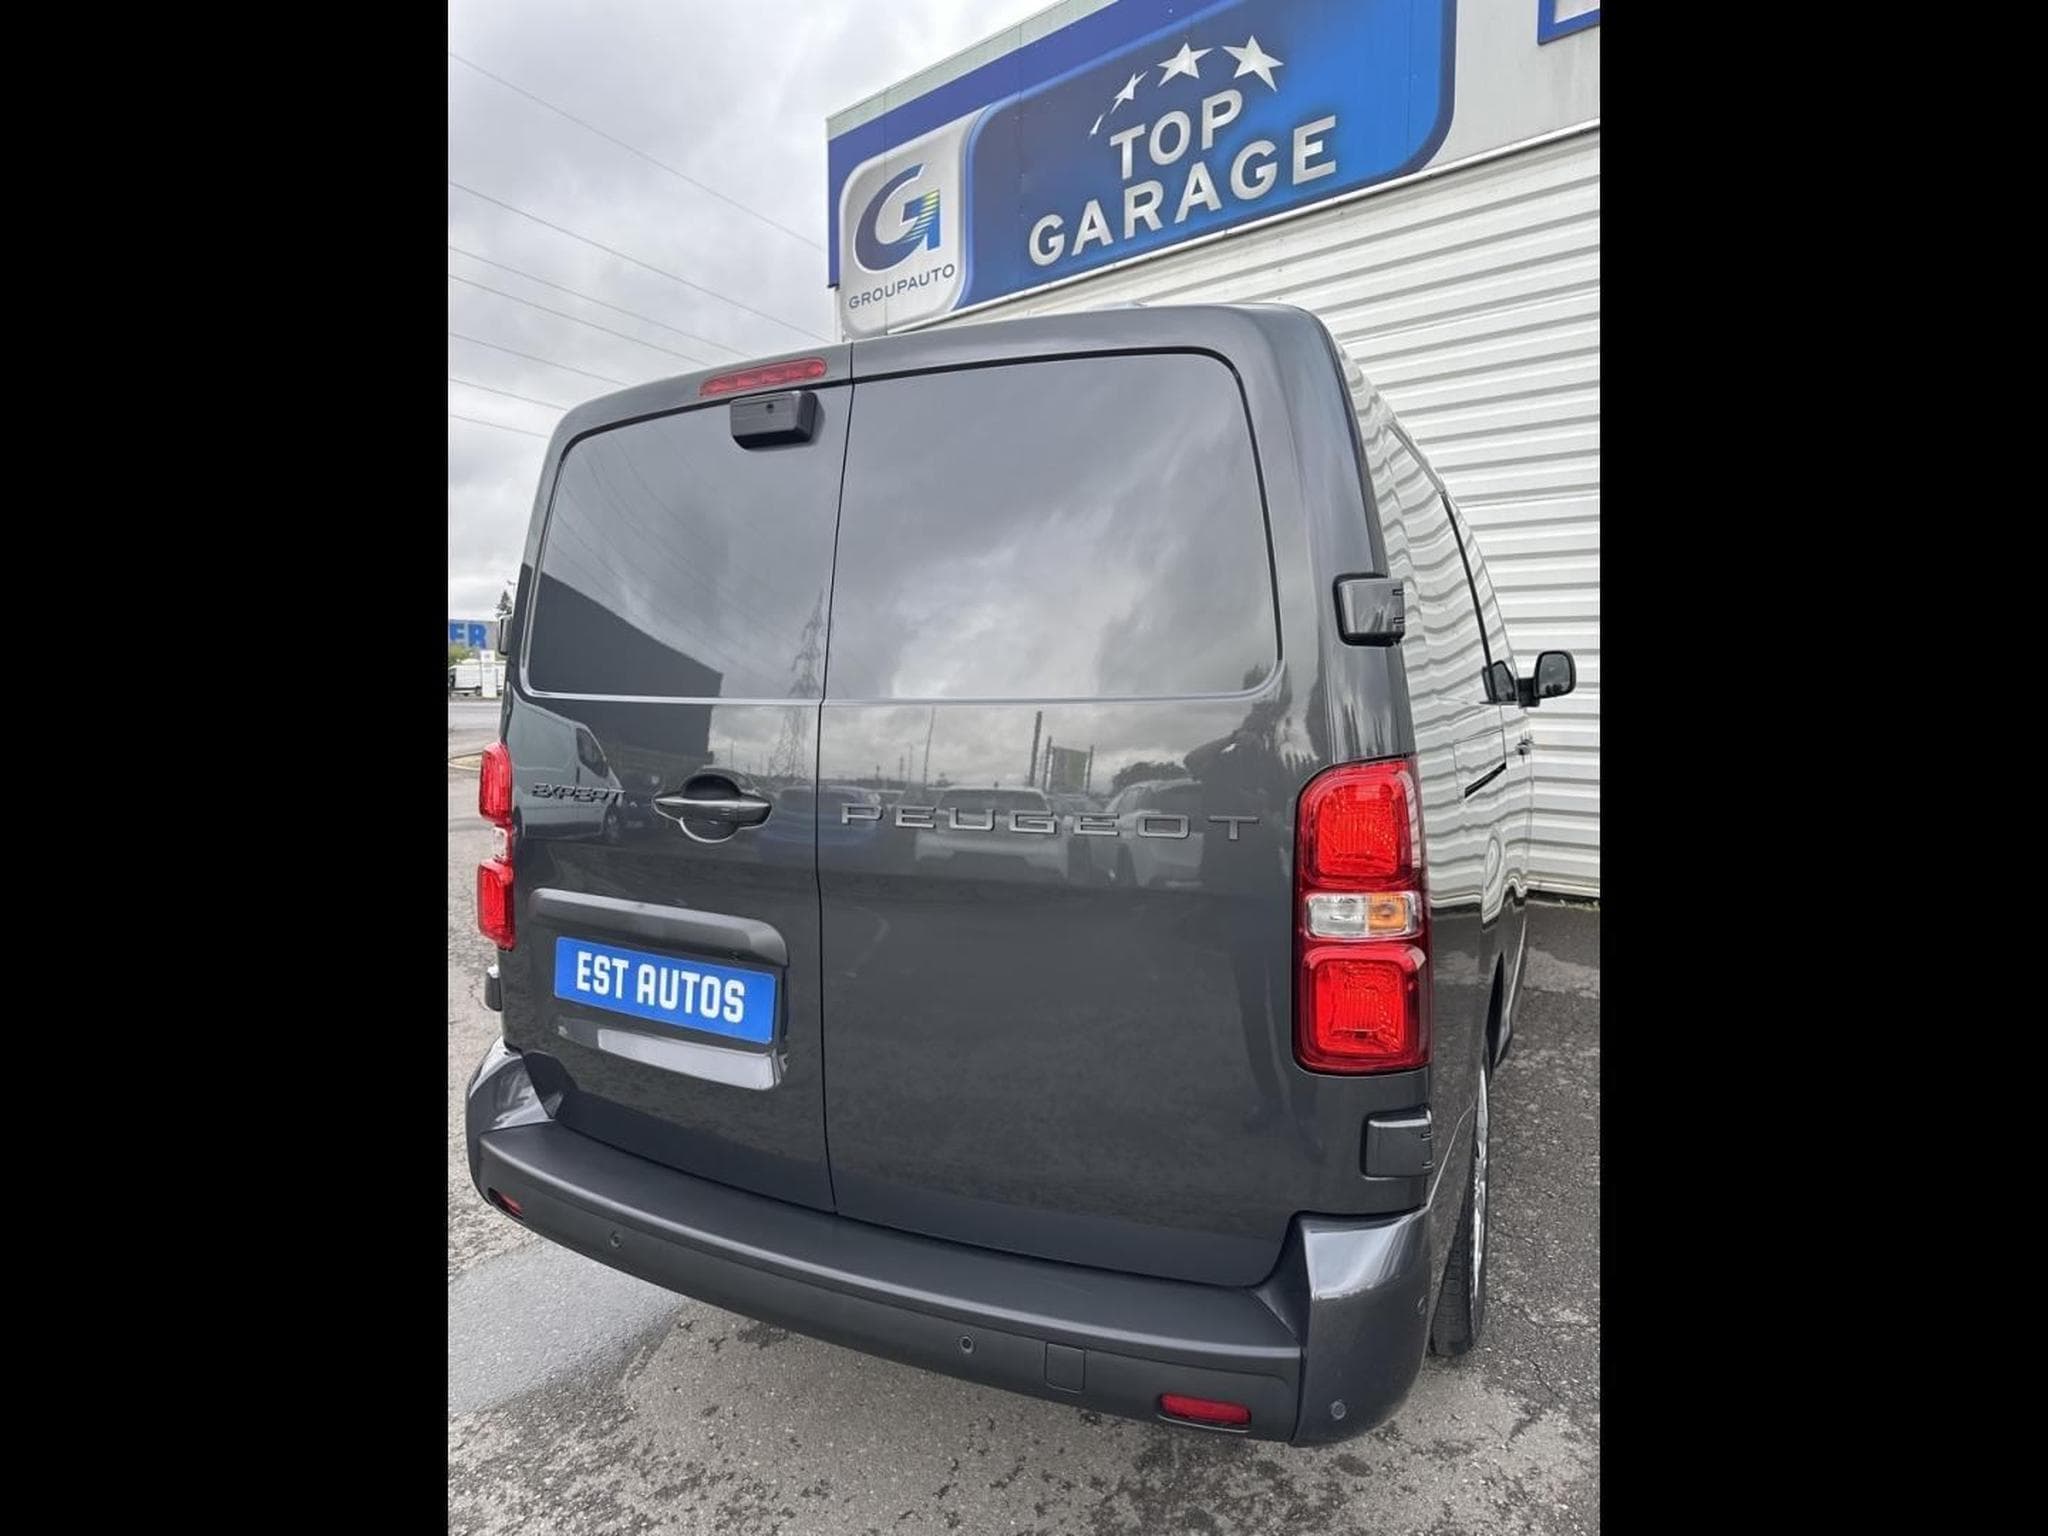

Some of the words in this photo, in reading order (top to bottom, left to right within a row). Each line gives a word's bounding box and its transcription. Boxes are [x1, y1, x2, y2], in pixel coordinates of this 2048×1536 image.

[1109, 88, 1244, 179] TOP
[1028, 114, 1338, 267] GARAGE
[848, 262, 956, 310] GROUPAUTO
[531, 782, 625, 803] EXPERT
[841, 803, 1260, 840] PEUGEOT
[576, 950, 630, 999] EST
[636, 962, 746, 1024] AUTOS
